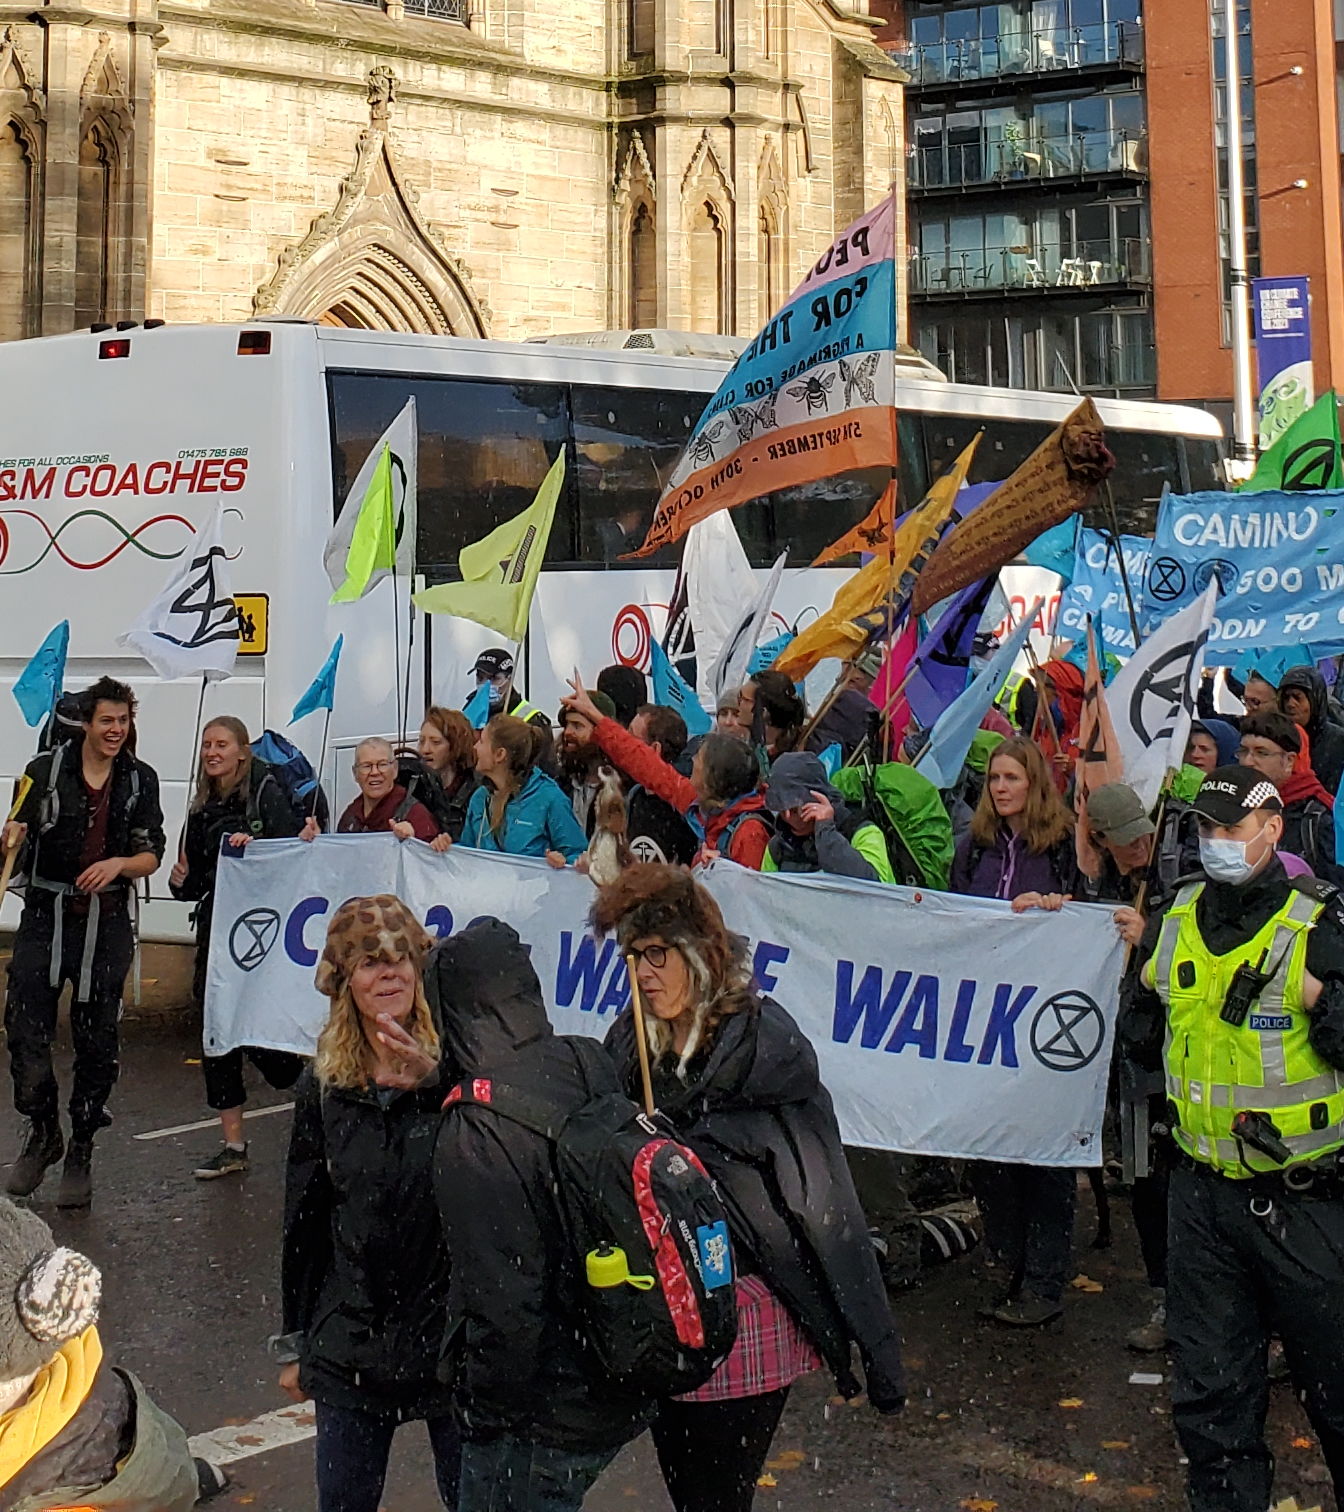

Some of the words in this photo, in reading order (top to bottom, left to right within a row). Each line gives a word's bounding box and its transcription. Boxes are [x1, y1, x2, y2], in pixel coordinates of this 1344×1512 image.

[18, 458, 35, 468] FOR
[37, 456, 53, 467] ALL
[56, 454, 109, 466] OCCASIONS
[64, 458, 248, 498] COACHES
[1236, 566, 1303, 596] 500
[1283, 612, 1321, 635] TO
[1200, 780, 1238, 796] POLICE
[832, 959, 1039, 1068] WALK
[1252, 1016, 1291, 1029] POLICE
